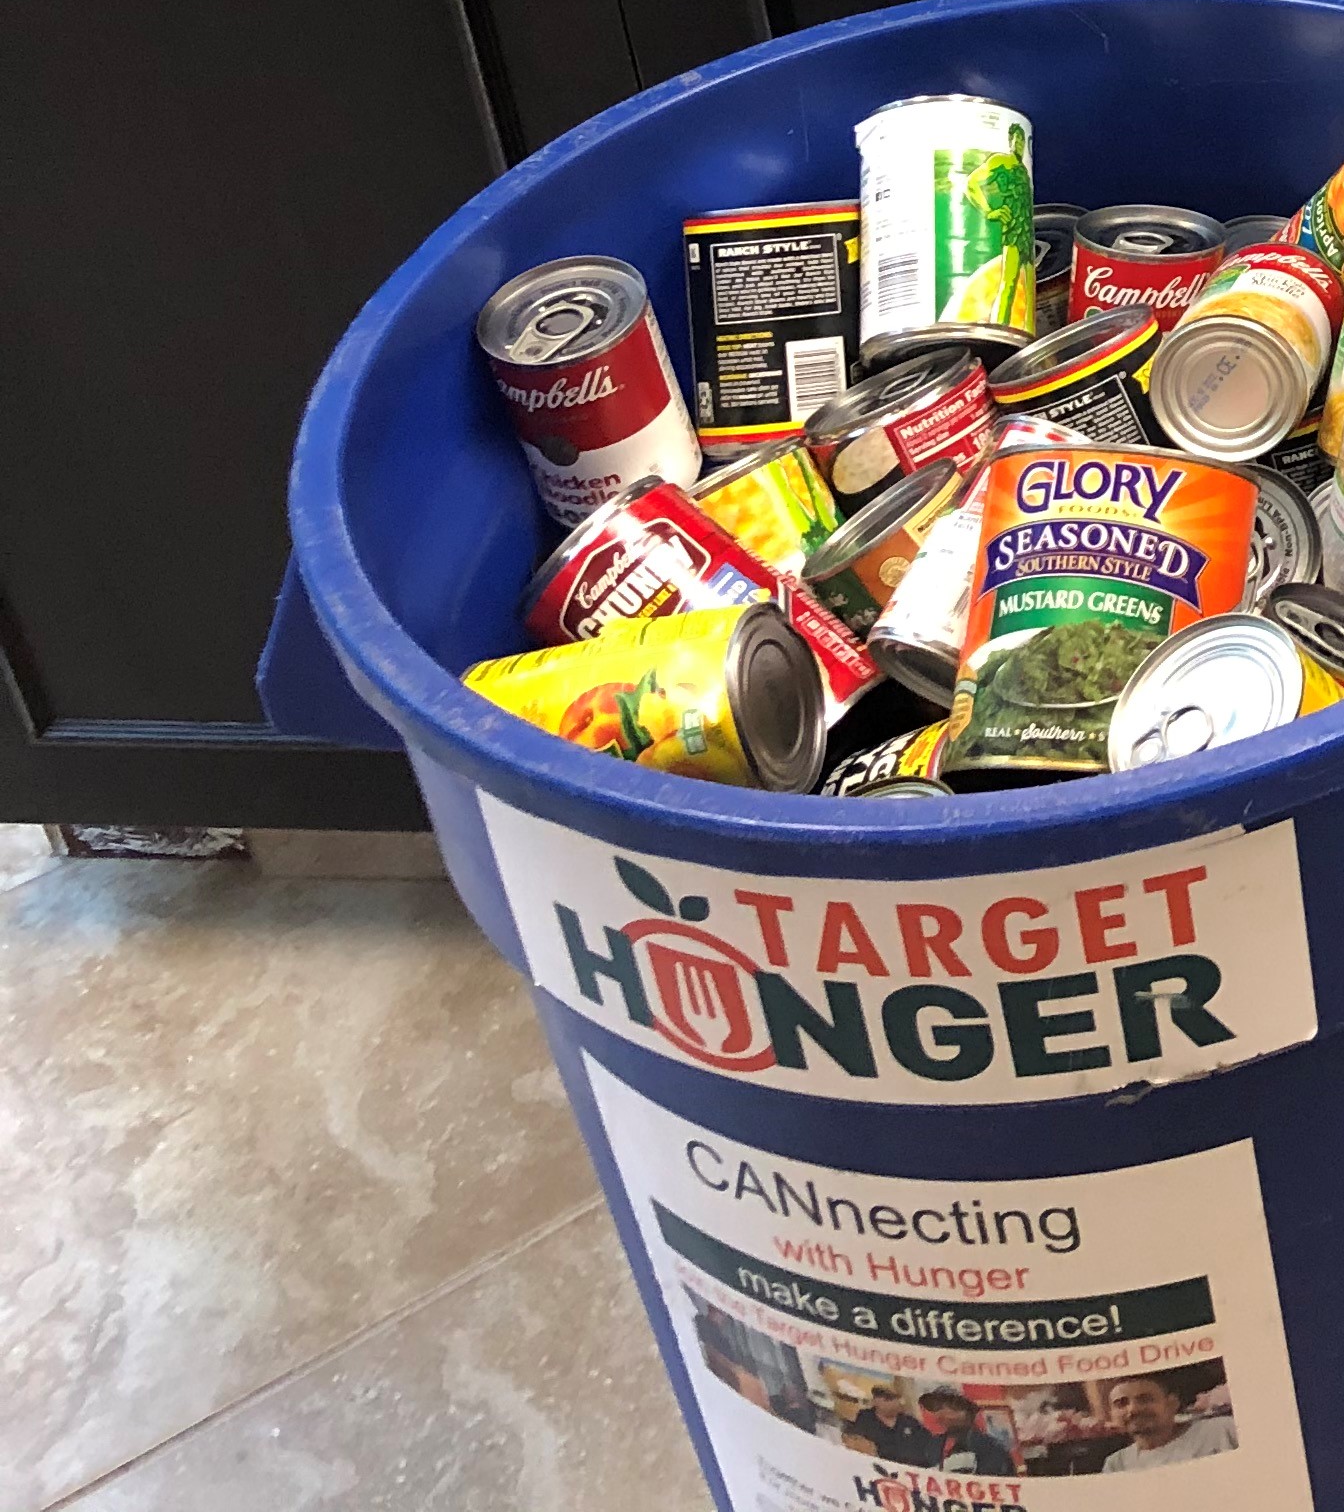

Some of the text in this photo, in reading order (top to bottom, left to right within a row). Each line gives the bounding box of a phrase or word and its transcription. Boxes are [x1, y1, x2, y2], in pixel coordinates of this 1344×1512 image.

[901, 398, 963, 438] Nutrition
[1016, 460, 1183, 525] GLORY
[994, 523, 1190, 581] SEASONED
[1015, 556, 1152, 582] SOUTHERN STYLE
[999, 590, 1164, 624] MUSTARD GREENS
[734, 866, 1207, 977] TARGET
[685, 1139, 1082, 1255] CANnecting
[773, 1235, 1031, 1299] with Hunger
[737, 1264, 1122, 1343] make a difference!
[754, 1302, 826, 1350] Target
[831, 1332, 926, 1373] Hunger
[937, 1352, 1048, 1380] Canned
[1057, 1348, 1129, 1377] Food
[1140, 1334, 1215, 1364] Drive
[905, 1472, 1022, 1505] TARGET
